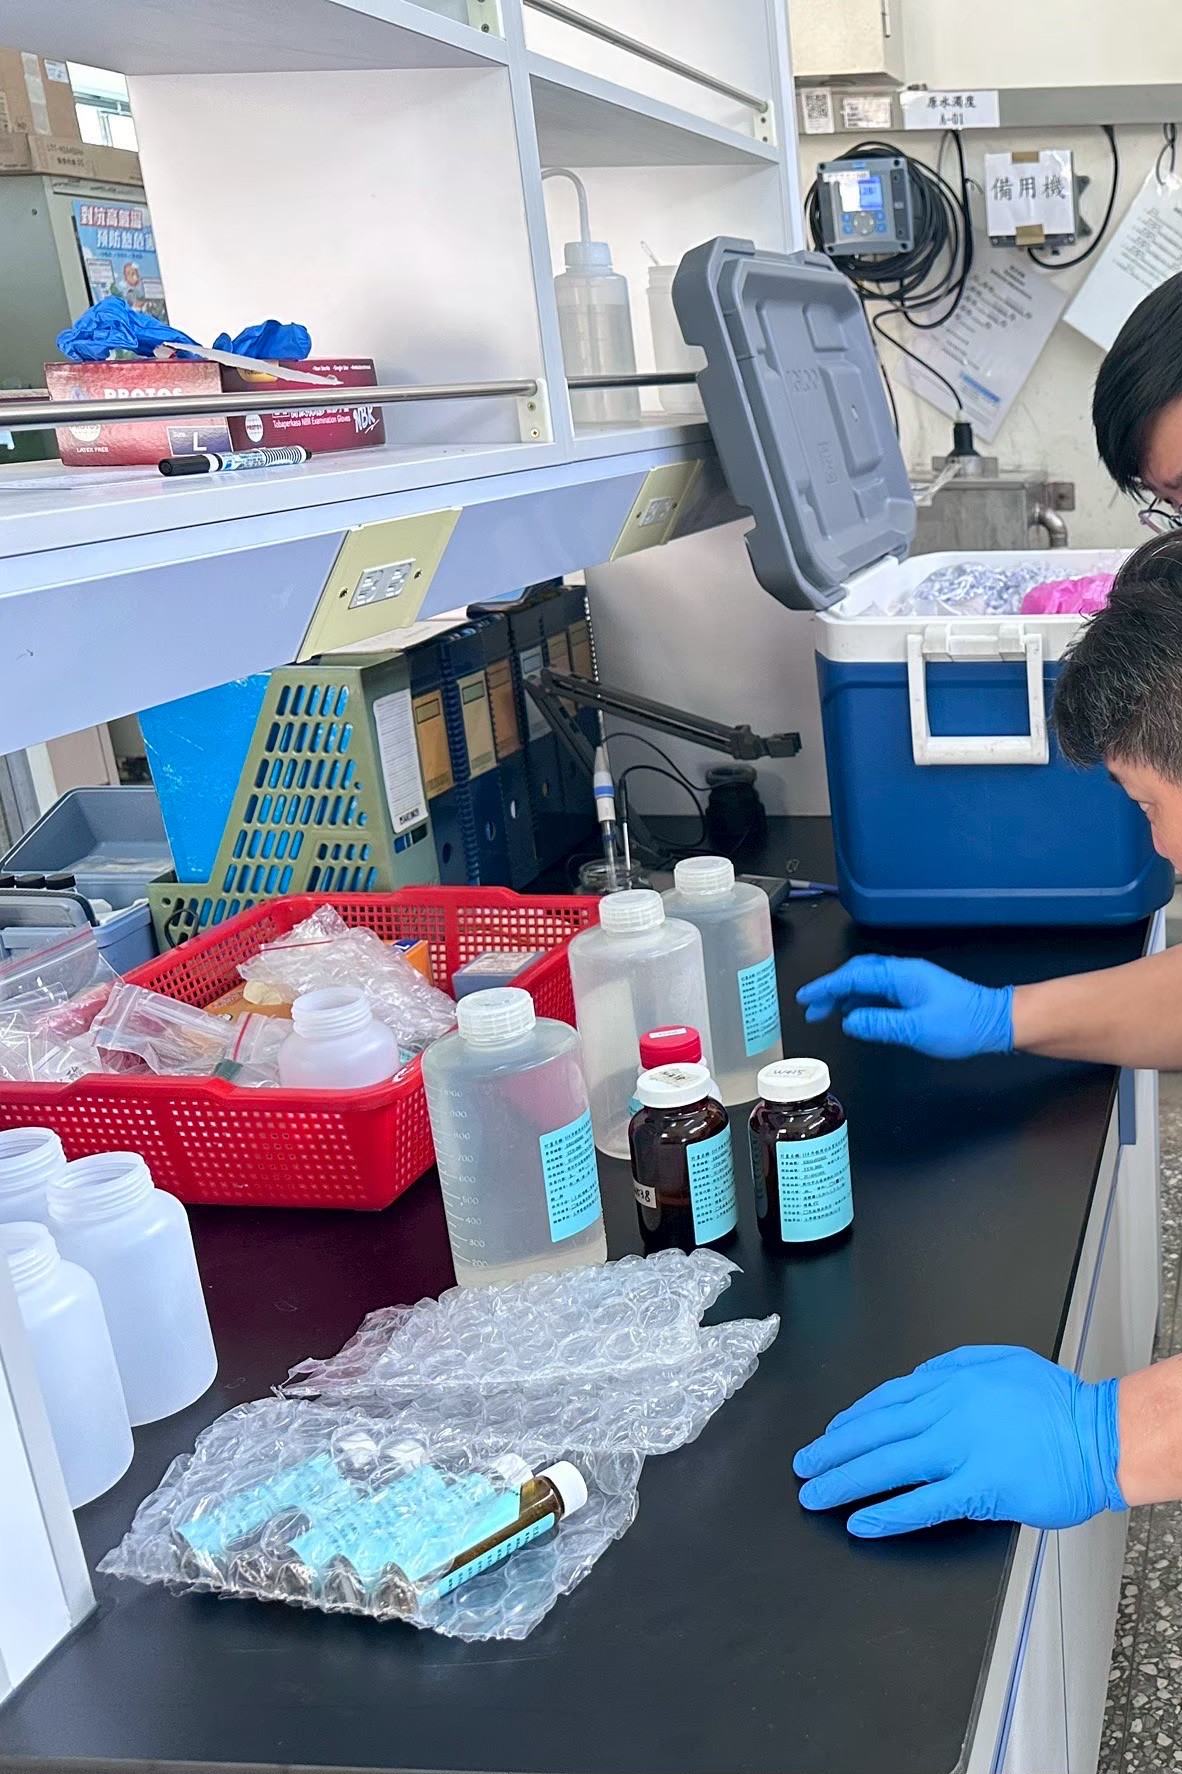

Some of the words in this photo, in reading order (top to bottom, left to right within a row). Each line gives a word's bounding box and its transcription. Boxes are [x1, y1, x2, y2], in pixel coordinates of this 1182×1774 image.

[927, 95, 976, 109] 原水濁度
[939, 112, 964, 125] A-01
[991, 175, 1067, 201] 備用機
[81, 205, 143, 230] 對抗高氣溫
[193, 431, 207, 452] L
[457, 1154, 474, 1164] 700
[458, 1175, 476, 1184] 600
[461, 1196, 479, 1205] 500
[465, 1216, 482, 1226] 400
[469, 1238, 486, 1248] 300
[471, 1259, 488, 1268] 200
